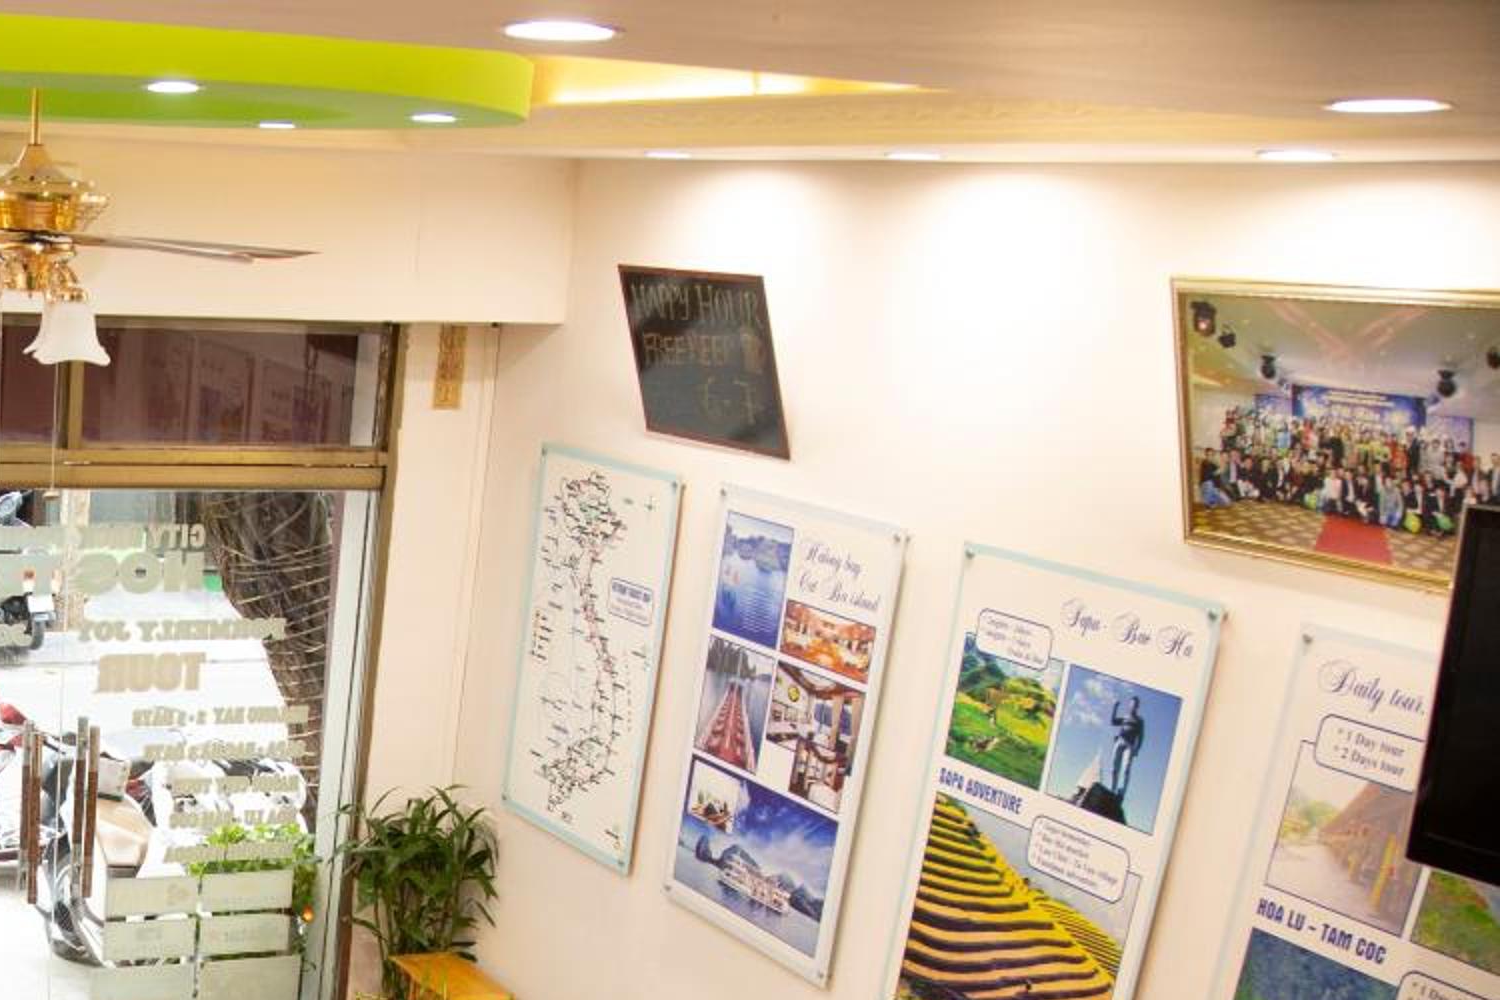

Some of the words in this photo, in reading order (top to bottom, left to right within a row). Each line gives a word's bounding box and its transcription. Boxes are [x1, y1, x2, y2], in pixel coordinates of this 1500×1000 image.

[631, 283, 689, 321] HAPPY
[1317, 659, 1384, 713] Daily
[965, 779, 1024, 815] ADVENTURE
[1256, 899, 1285, 922] HOA
[1287, 909, 1306, 932] LU
[1321, 923, 1353, 950] TAM
[1355, 939, 1387, 965] COC
